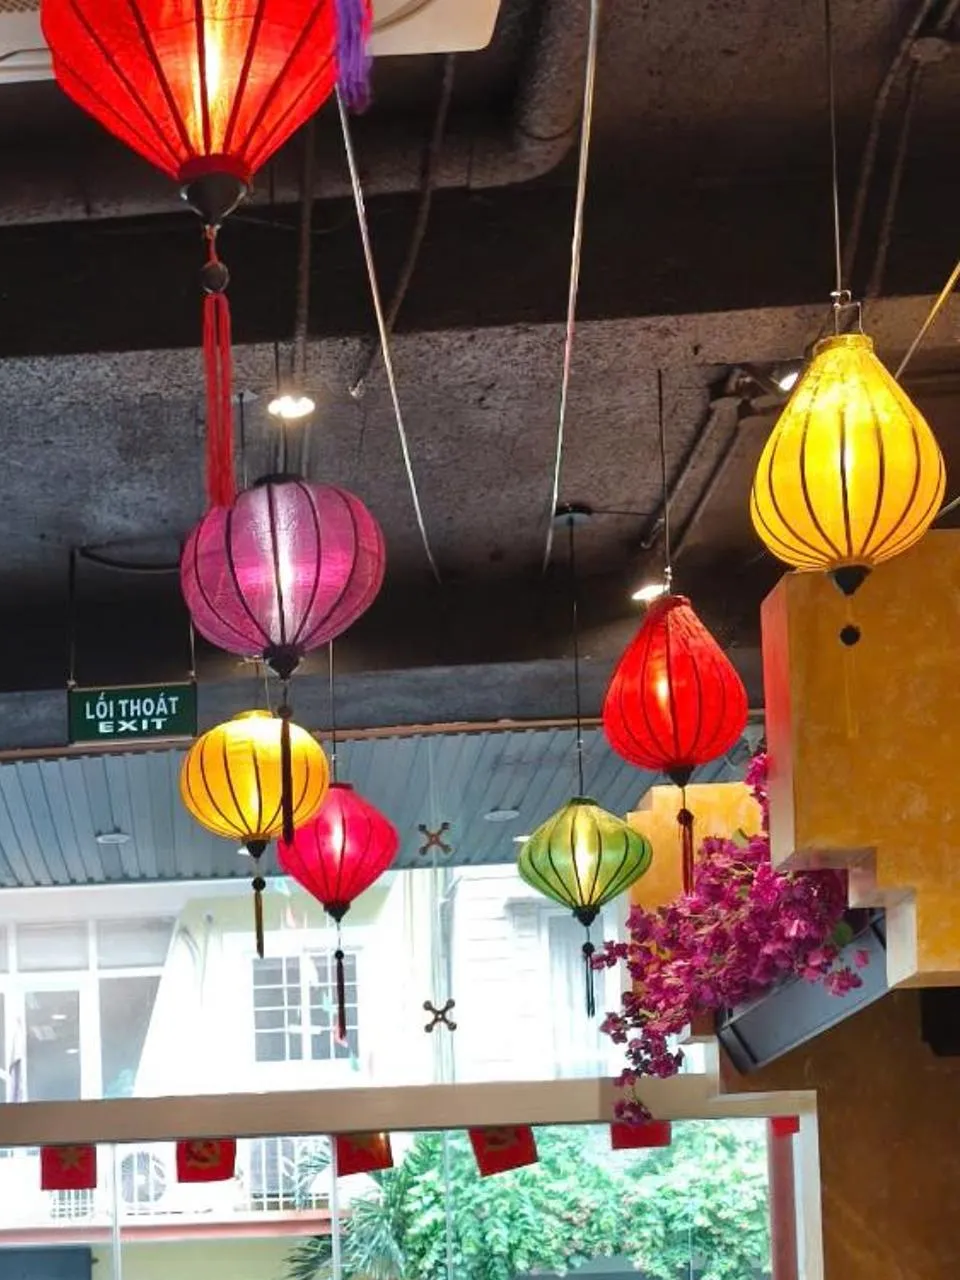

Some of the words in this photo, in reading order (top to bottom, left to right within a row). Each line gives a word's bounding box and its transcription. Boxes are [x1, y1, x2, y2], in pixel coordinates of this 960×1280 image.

[85, 691, 114, 719] LỐI
[118, 692, 180, 718] THOÁT
[98, 718, 167, 733] EXIT
